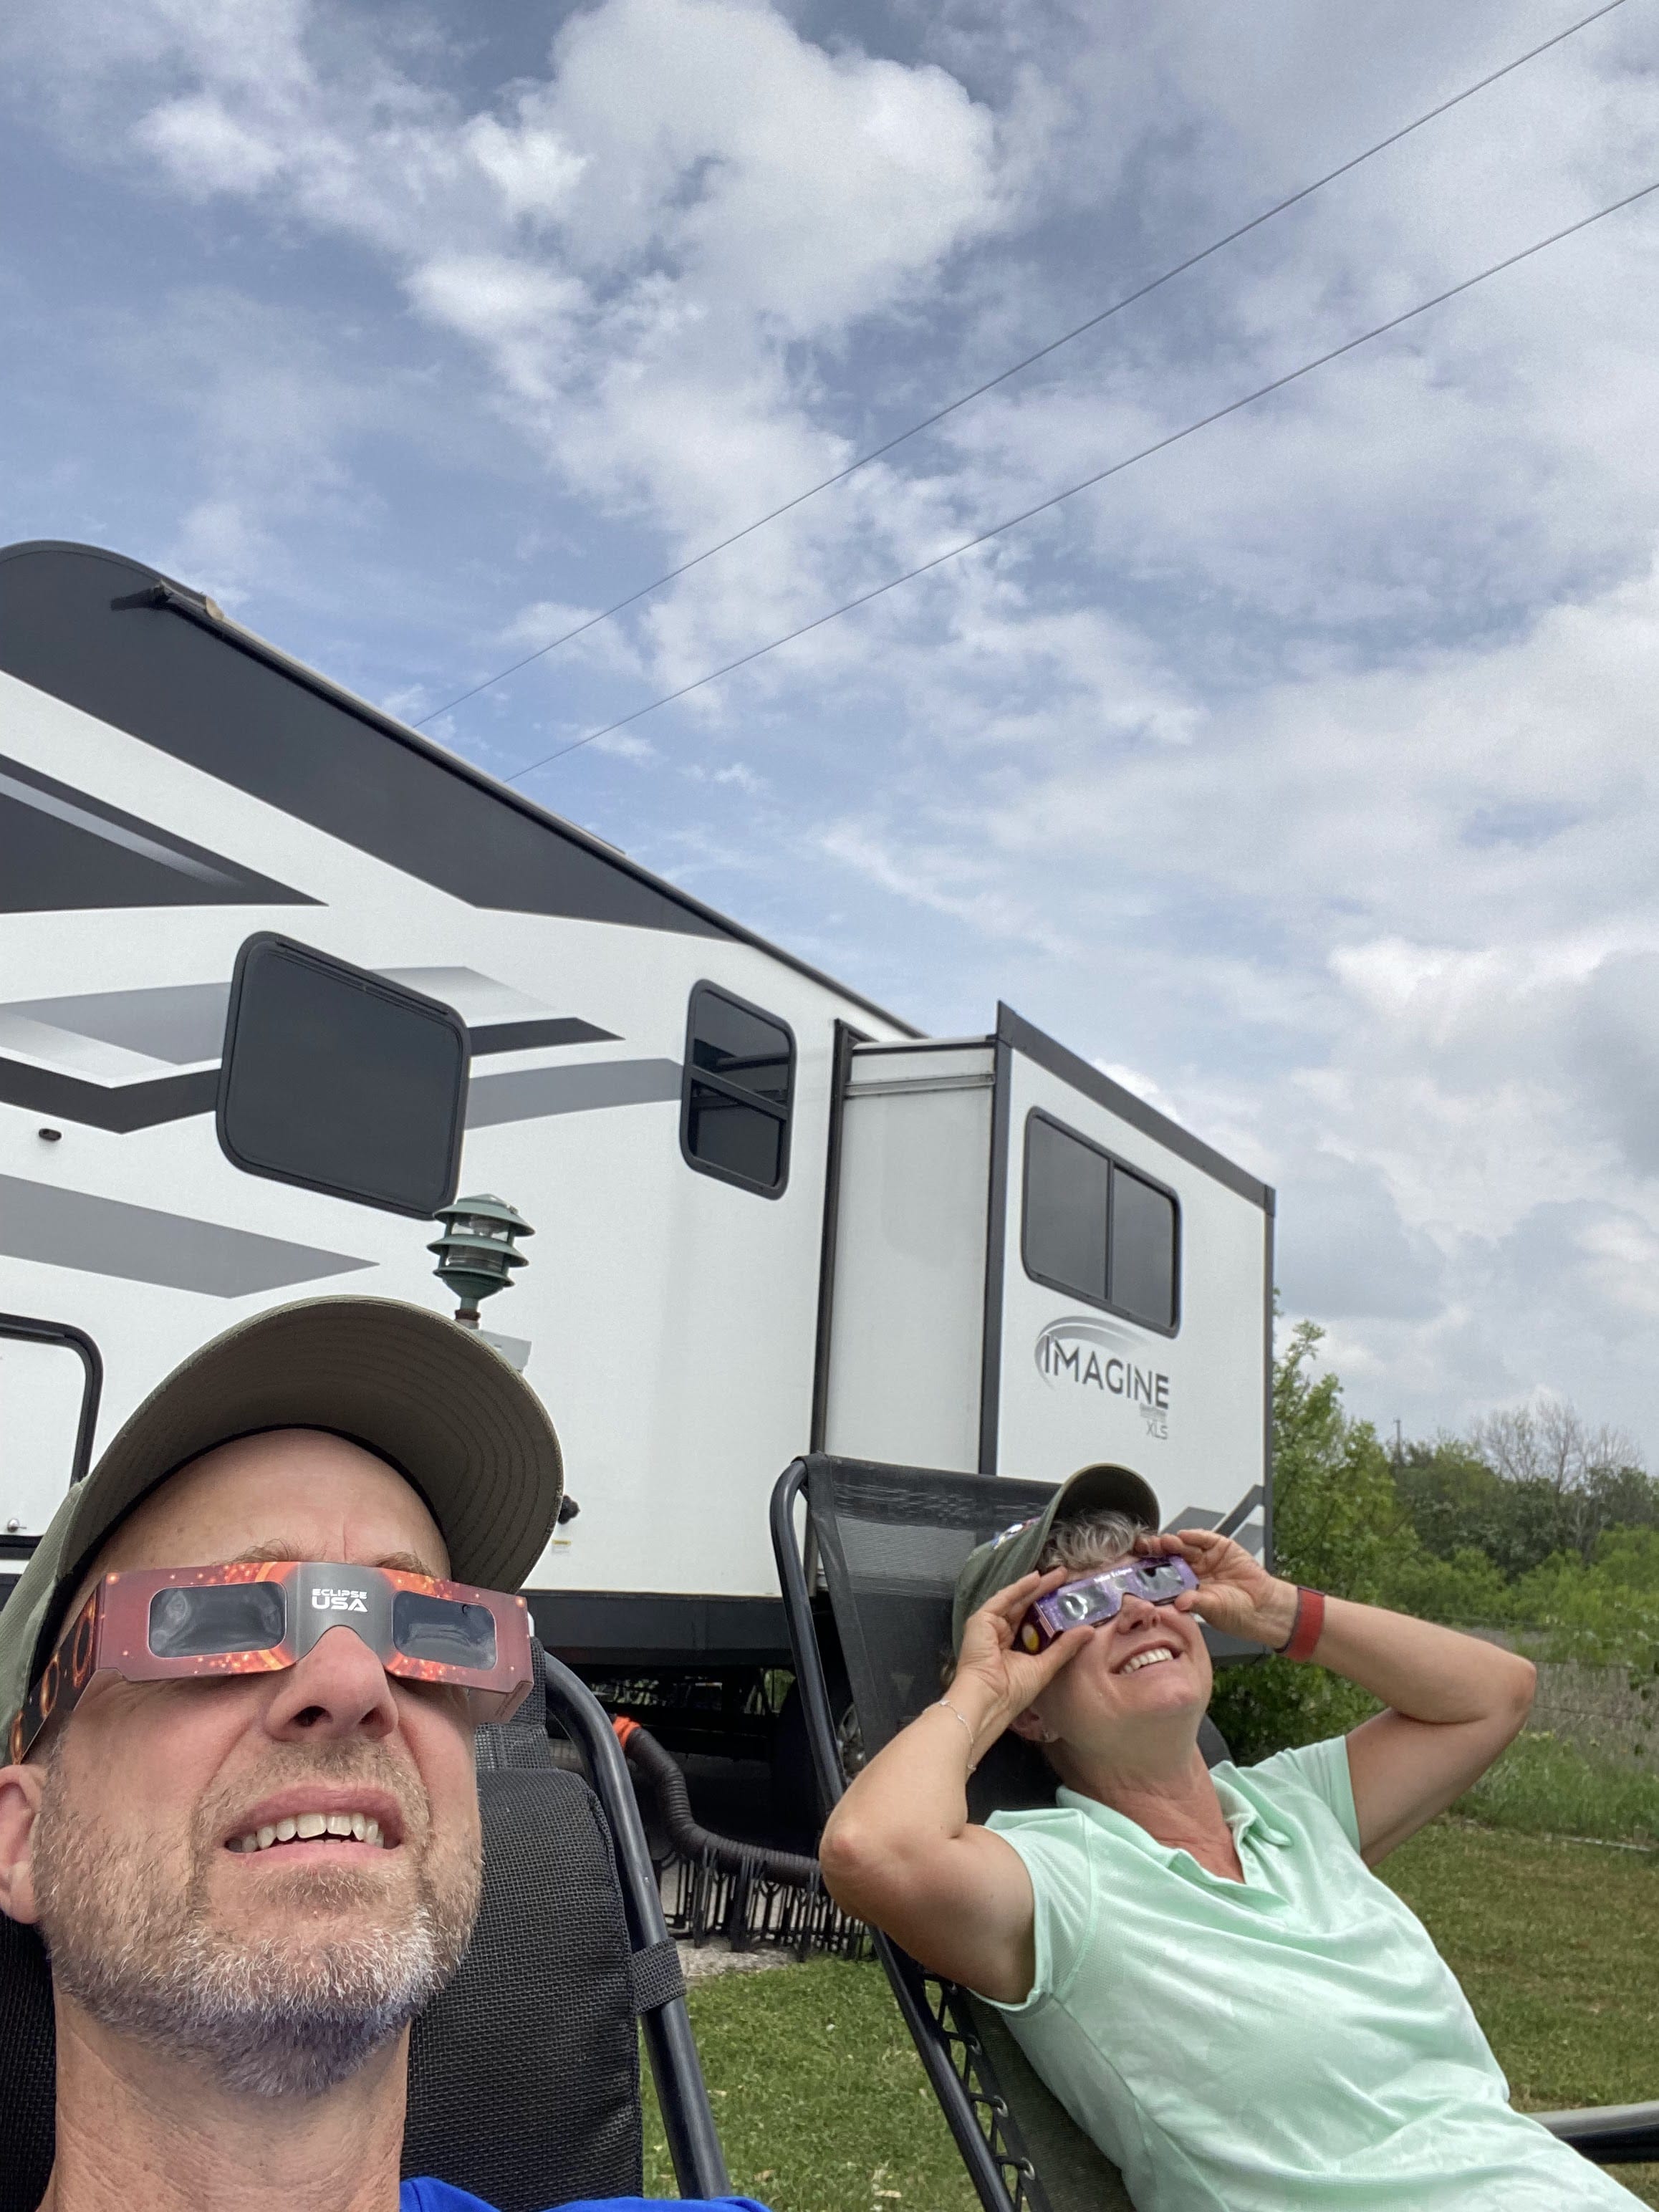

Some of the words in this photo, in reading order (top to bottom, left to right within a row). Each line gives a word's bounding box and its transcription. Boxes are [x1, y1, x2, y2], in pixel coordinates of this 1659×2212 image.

[1044, 1335, 1169, 1410] IMAGINE
[1146, 1421, 1168, 1440] XLS
[312, 1589, 367, 1599] ECLIPSE
[312, 1596, 367, 1612] USA
